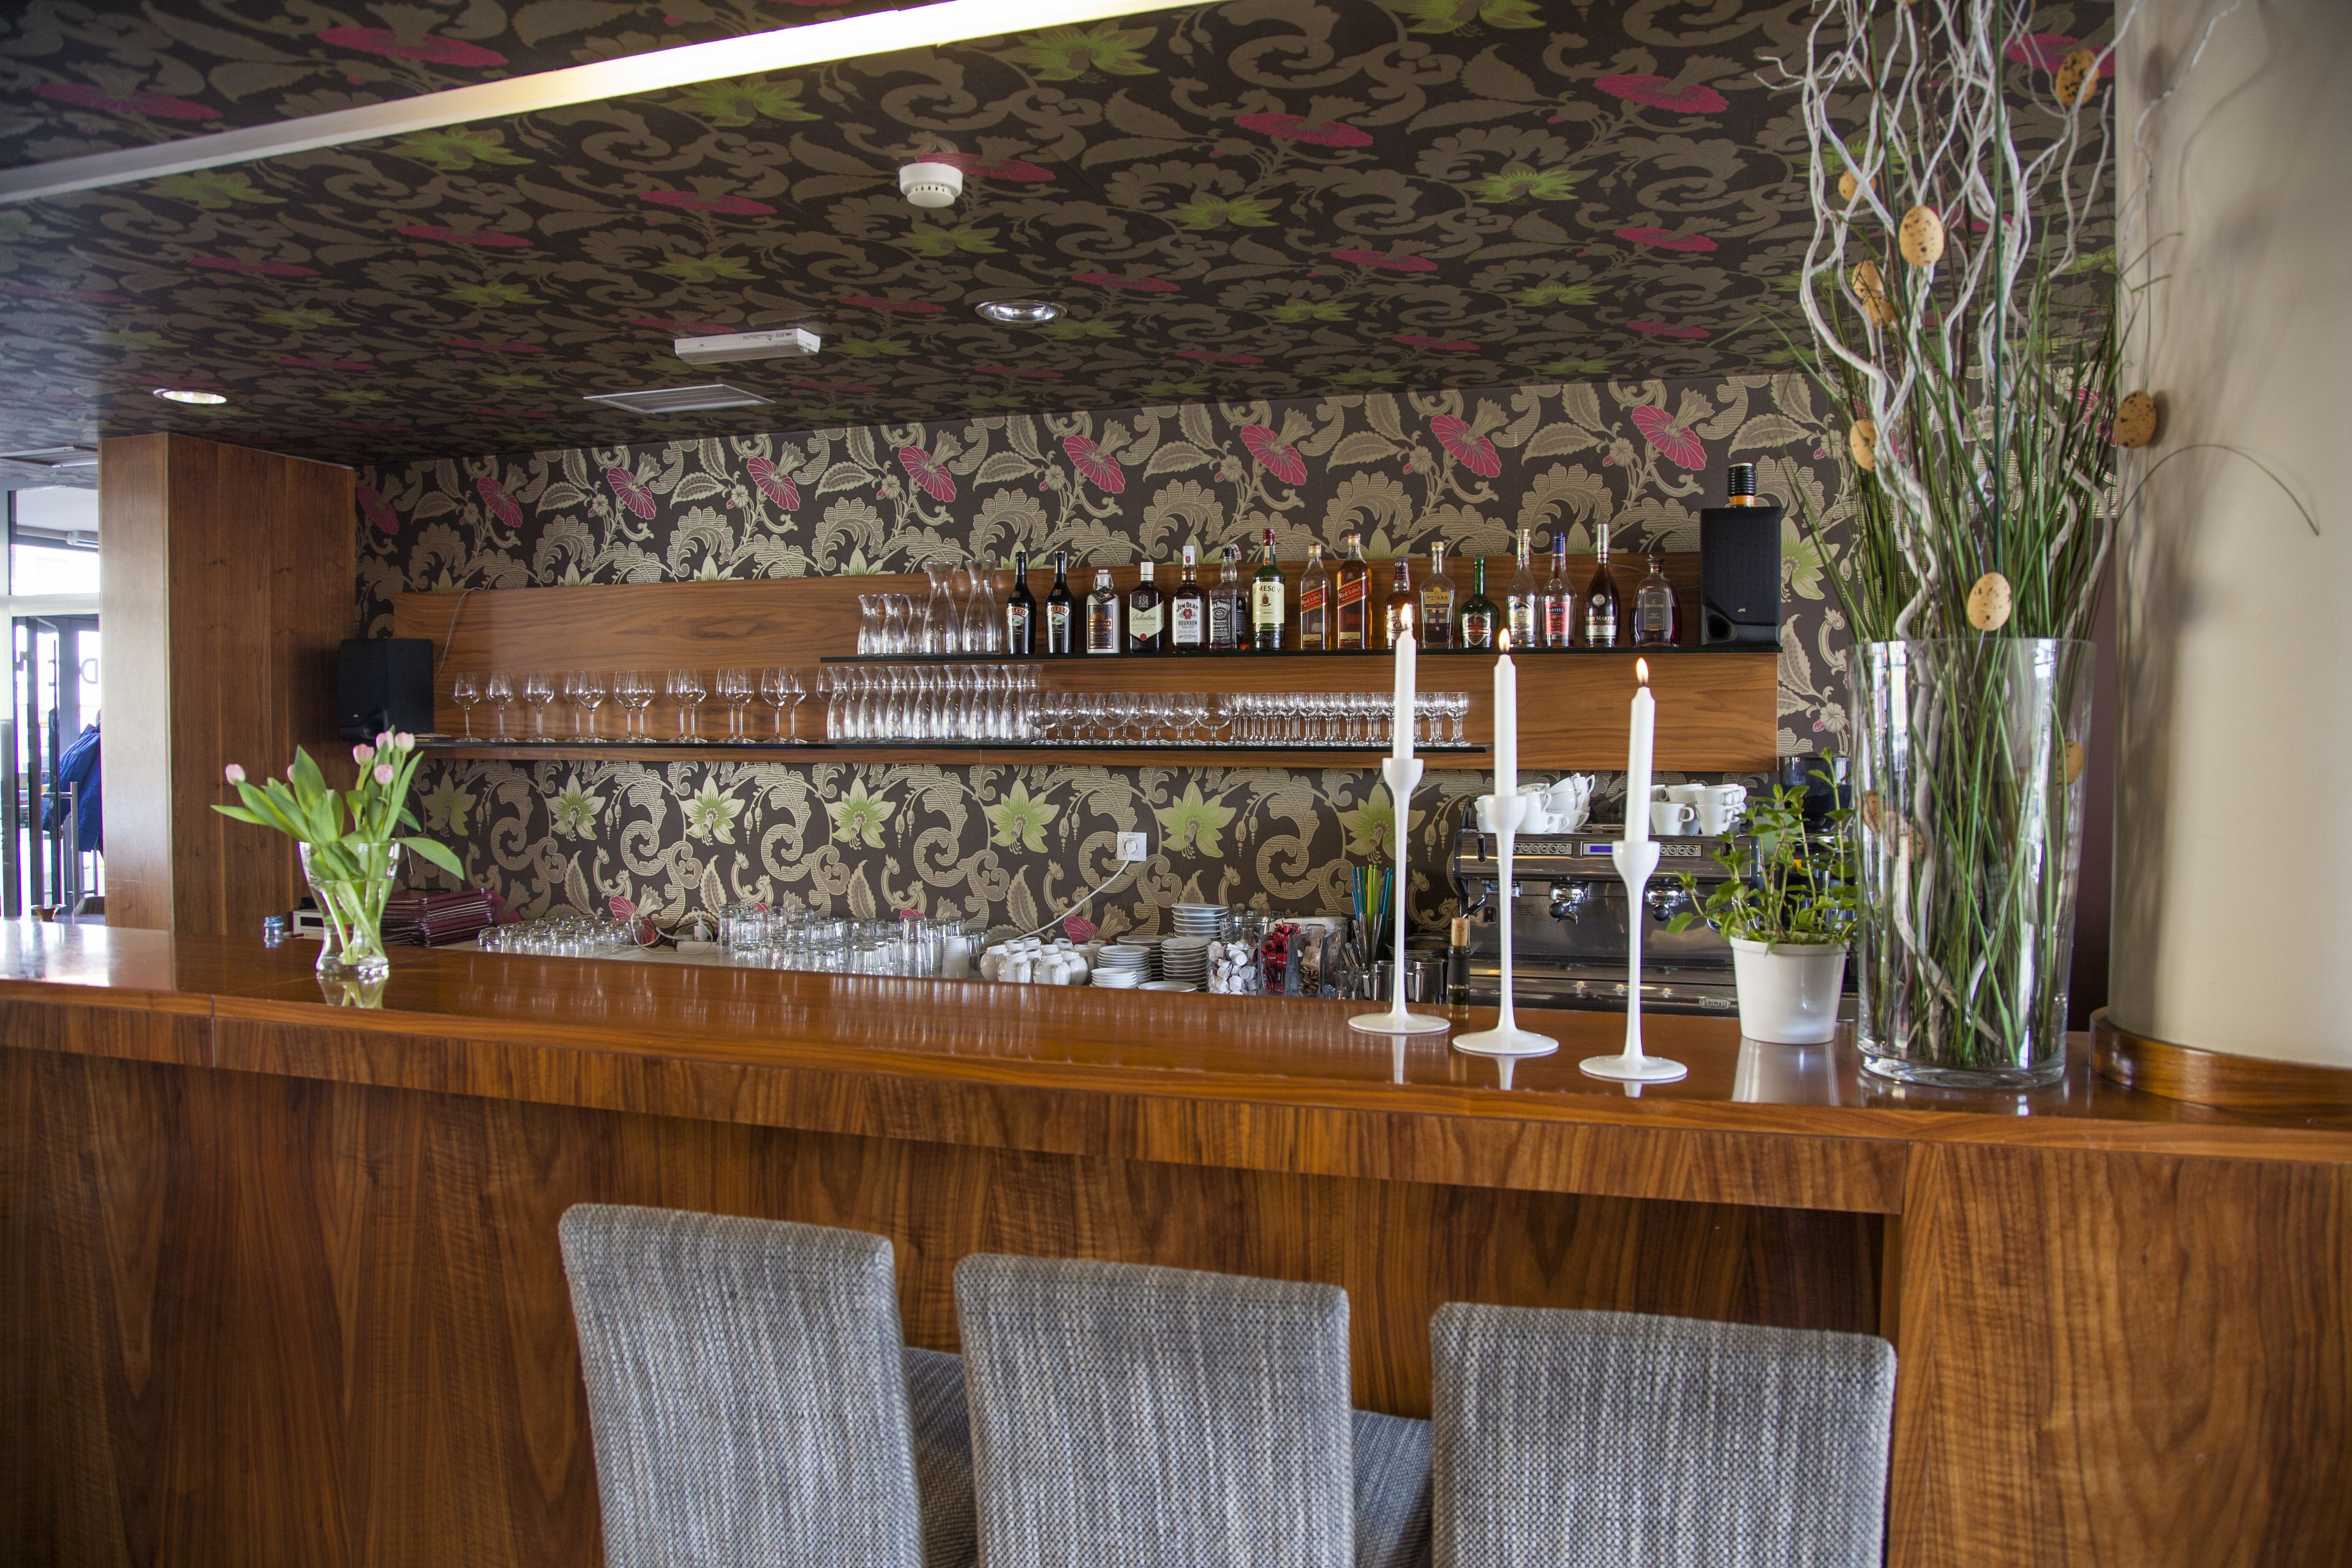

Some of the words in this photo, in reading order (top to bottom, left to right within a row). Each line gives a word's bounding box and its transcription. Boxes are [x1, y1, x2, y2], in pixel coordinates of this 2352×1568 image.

[1348, 586, 1362, 594] Label
[1310, 594, 1322, 602] Label
[1177, 603, 1186, 612] JIM
